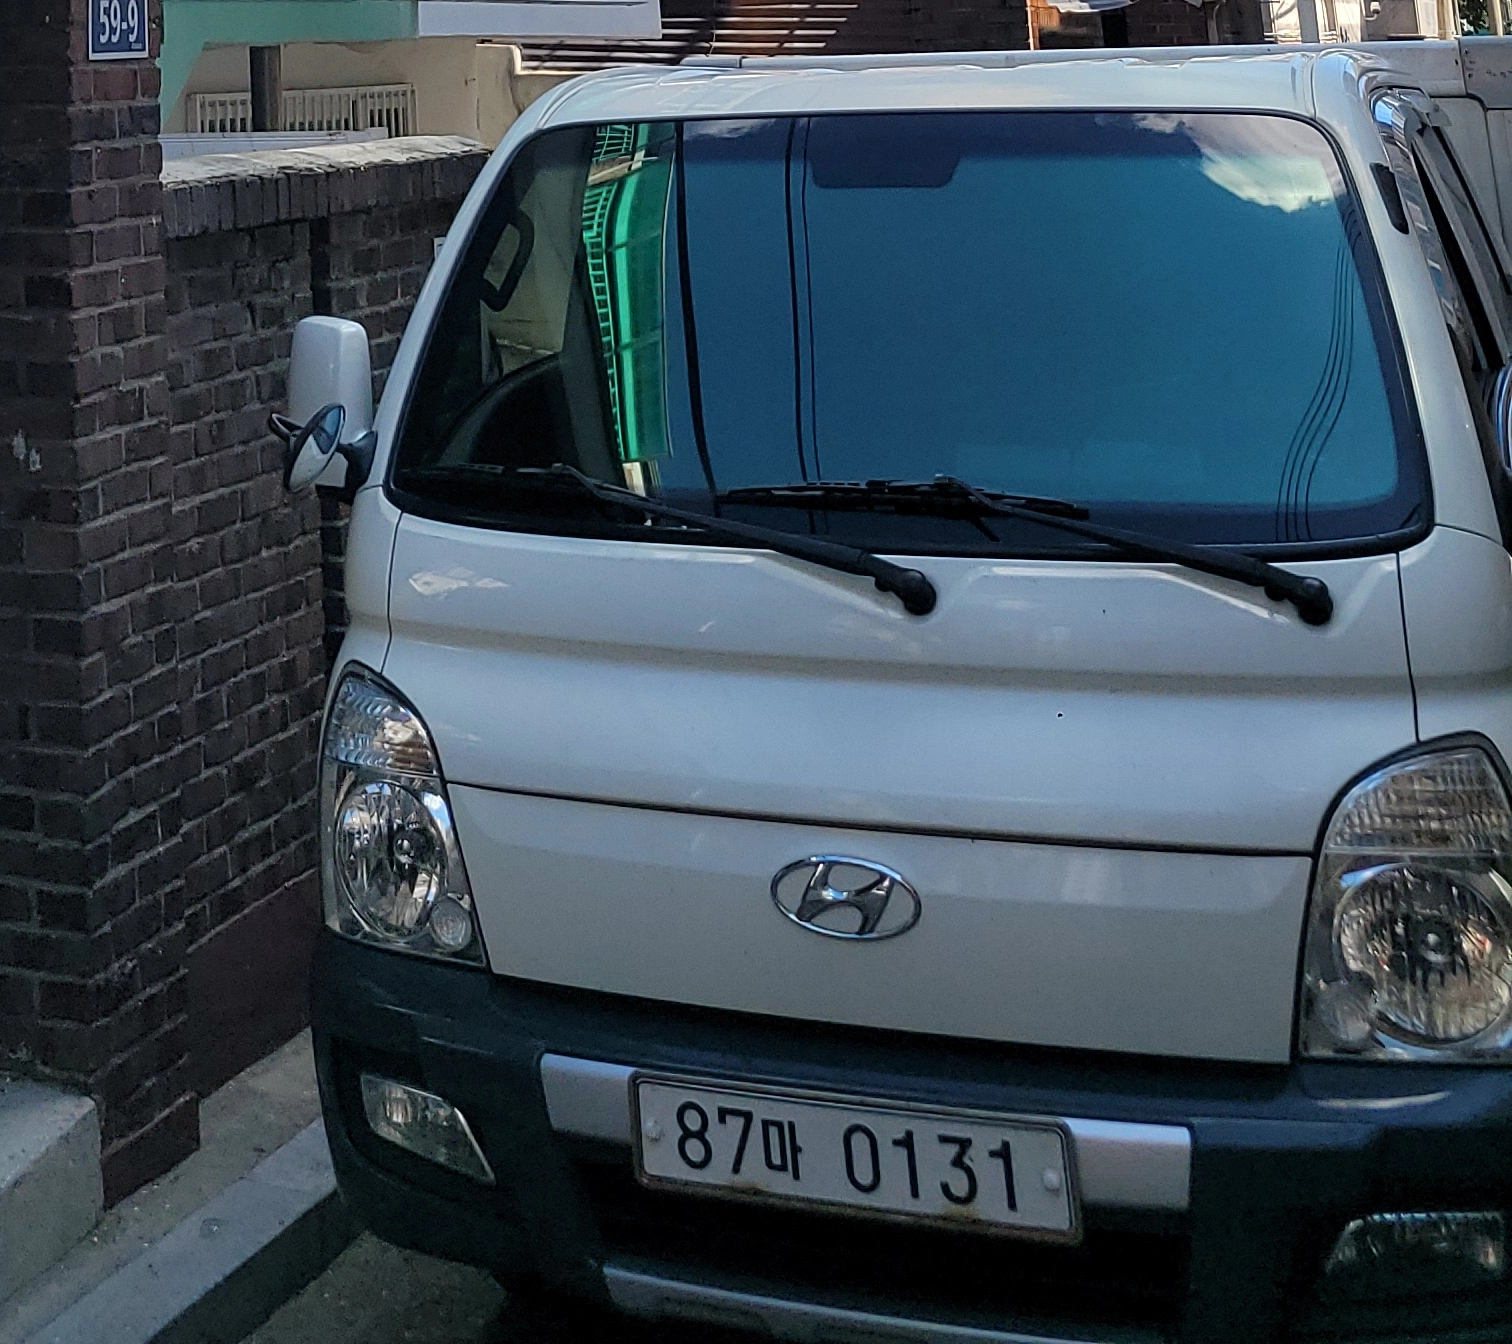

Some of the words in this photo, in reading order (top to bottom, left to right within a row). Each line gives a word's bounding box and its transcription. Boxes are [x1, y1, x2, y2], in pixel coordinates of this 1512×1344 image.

[99, 0, 139, 44] 59-9
[676, 1100, 802, 1180] 87마
[843, 1123, 1019, 1211] 0131
